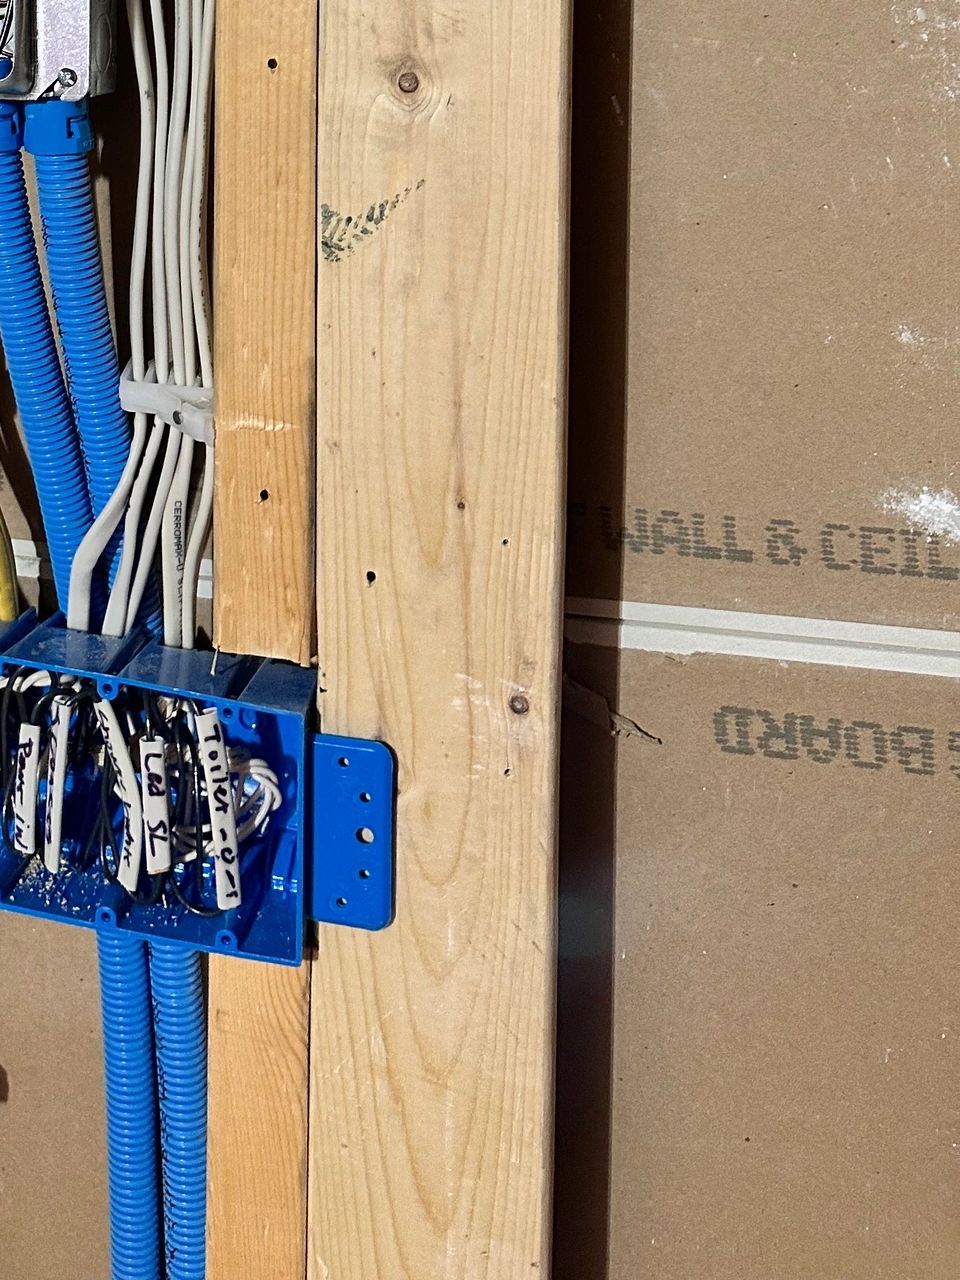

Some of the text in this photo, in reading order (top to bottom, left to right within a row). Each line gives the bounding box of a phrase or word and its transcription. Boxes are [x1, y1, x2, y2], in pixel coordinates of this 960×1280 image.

[600, 505, 753, 563] WALL
[764, 518, 807, 567] &
[713, 704, 935, 776] BOARD
